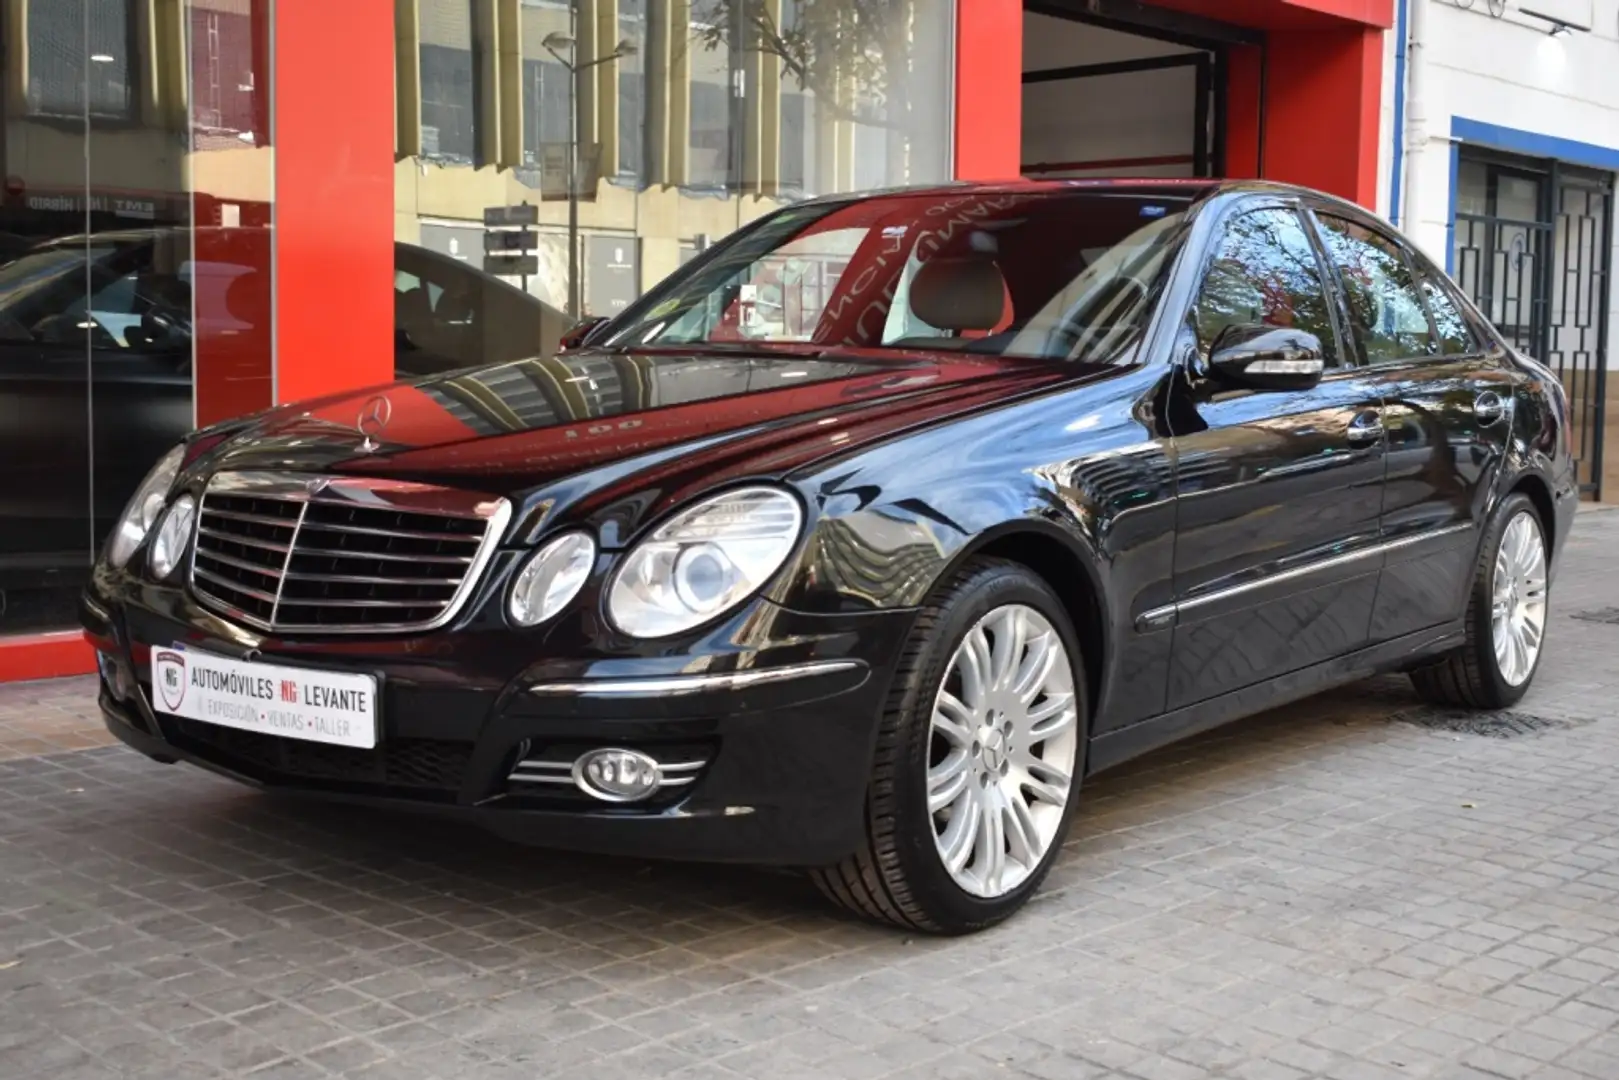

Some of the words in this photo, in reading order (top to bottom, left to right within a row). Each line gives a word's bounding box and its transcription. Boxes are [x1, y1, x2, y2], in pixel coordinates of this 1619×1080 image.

[191, 666, 274, 700] AUTOMÓVILES
[280, 679, 297, 703] NG
[304, 684, 366, 713] LEVANTE
[268, 710, 304, 731] VENTAS
[314, 715, 351, 738] TALLER
